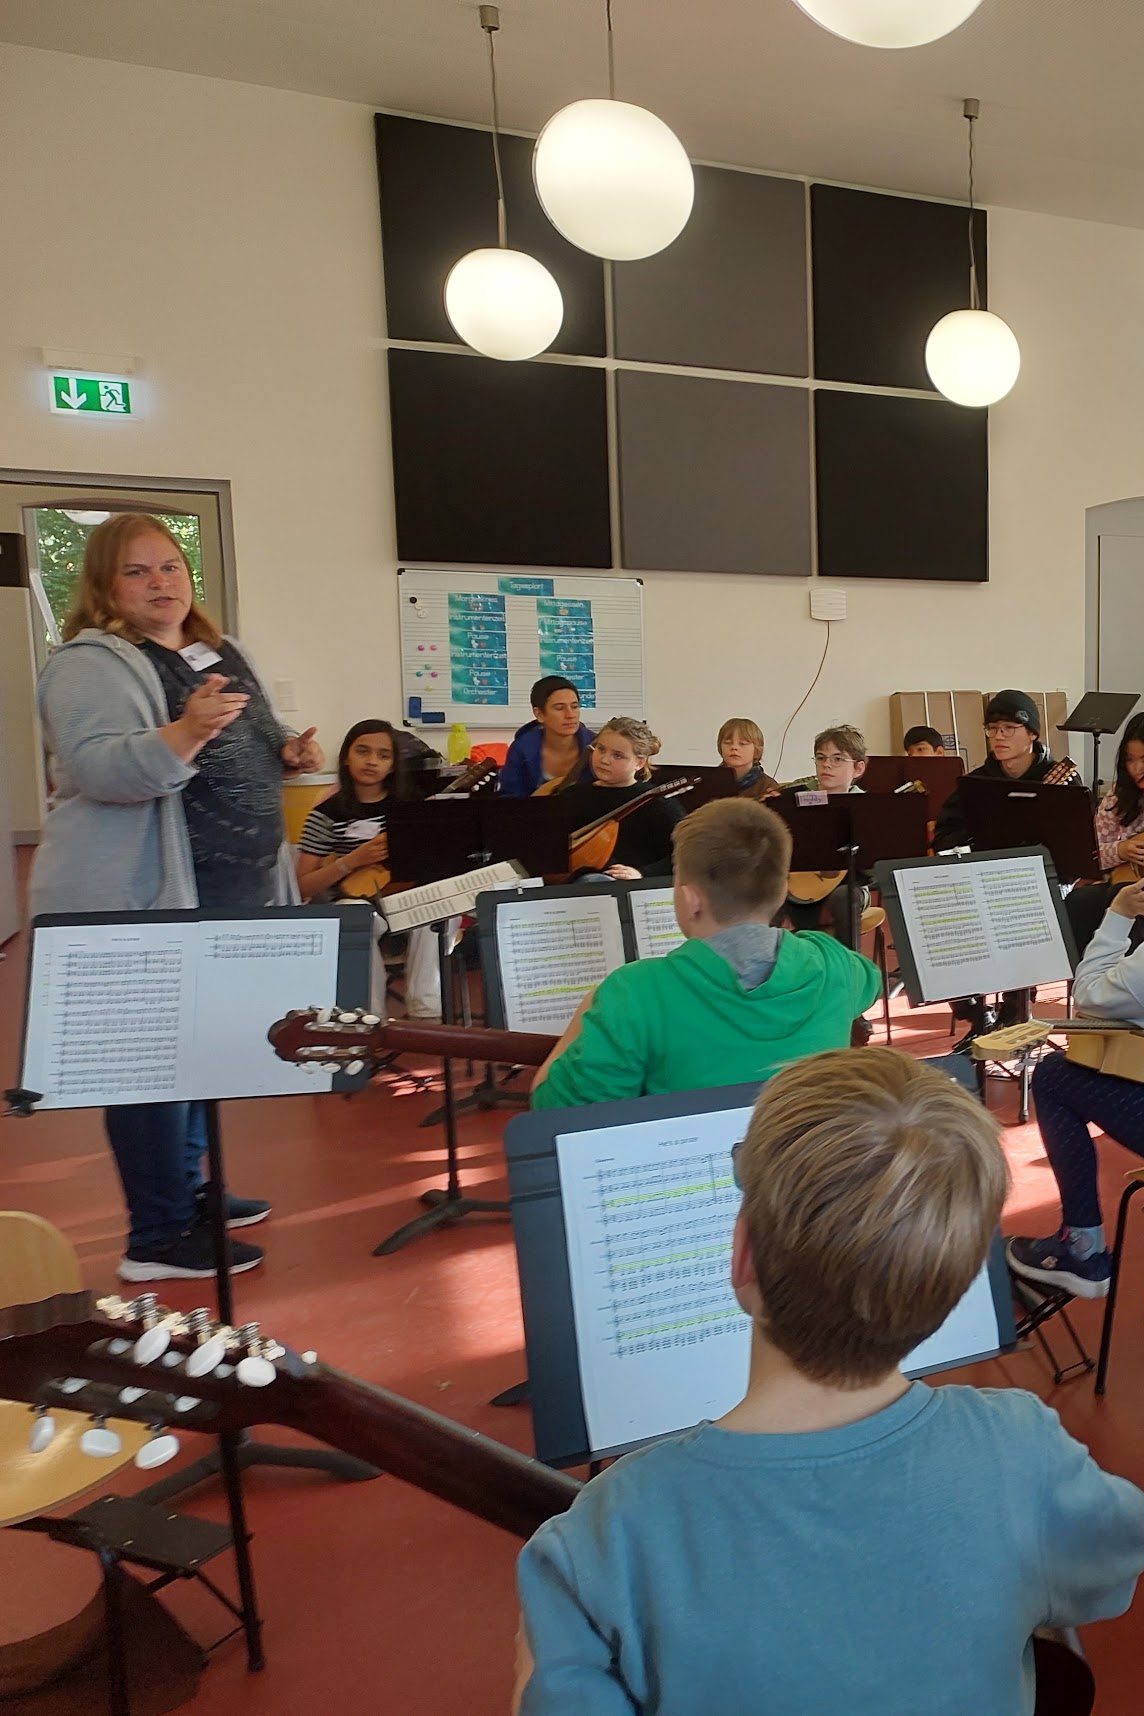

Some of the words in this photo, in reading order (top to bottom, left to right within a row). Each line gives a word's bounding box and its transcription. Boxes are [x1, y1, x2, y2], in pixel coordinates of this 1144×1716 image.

[544, 600, 584, 608] Mittagessen
[544, 618, 588, 627] Mittagspause
[467, 632, 489, 640] Pause
[469, 669, 491, 677] Pause
[463, 687, 497, 695] Orchester
